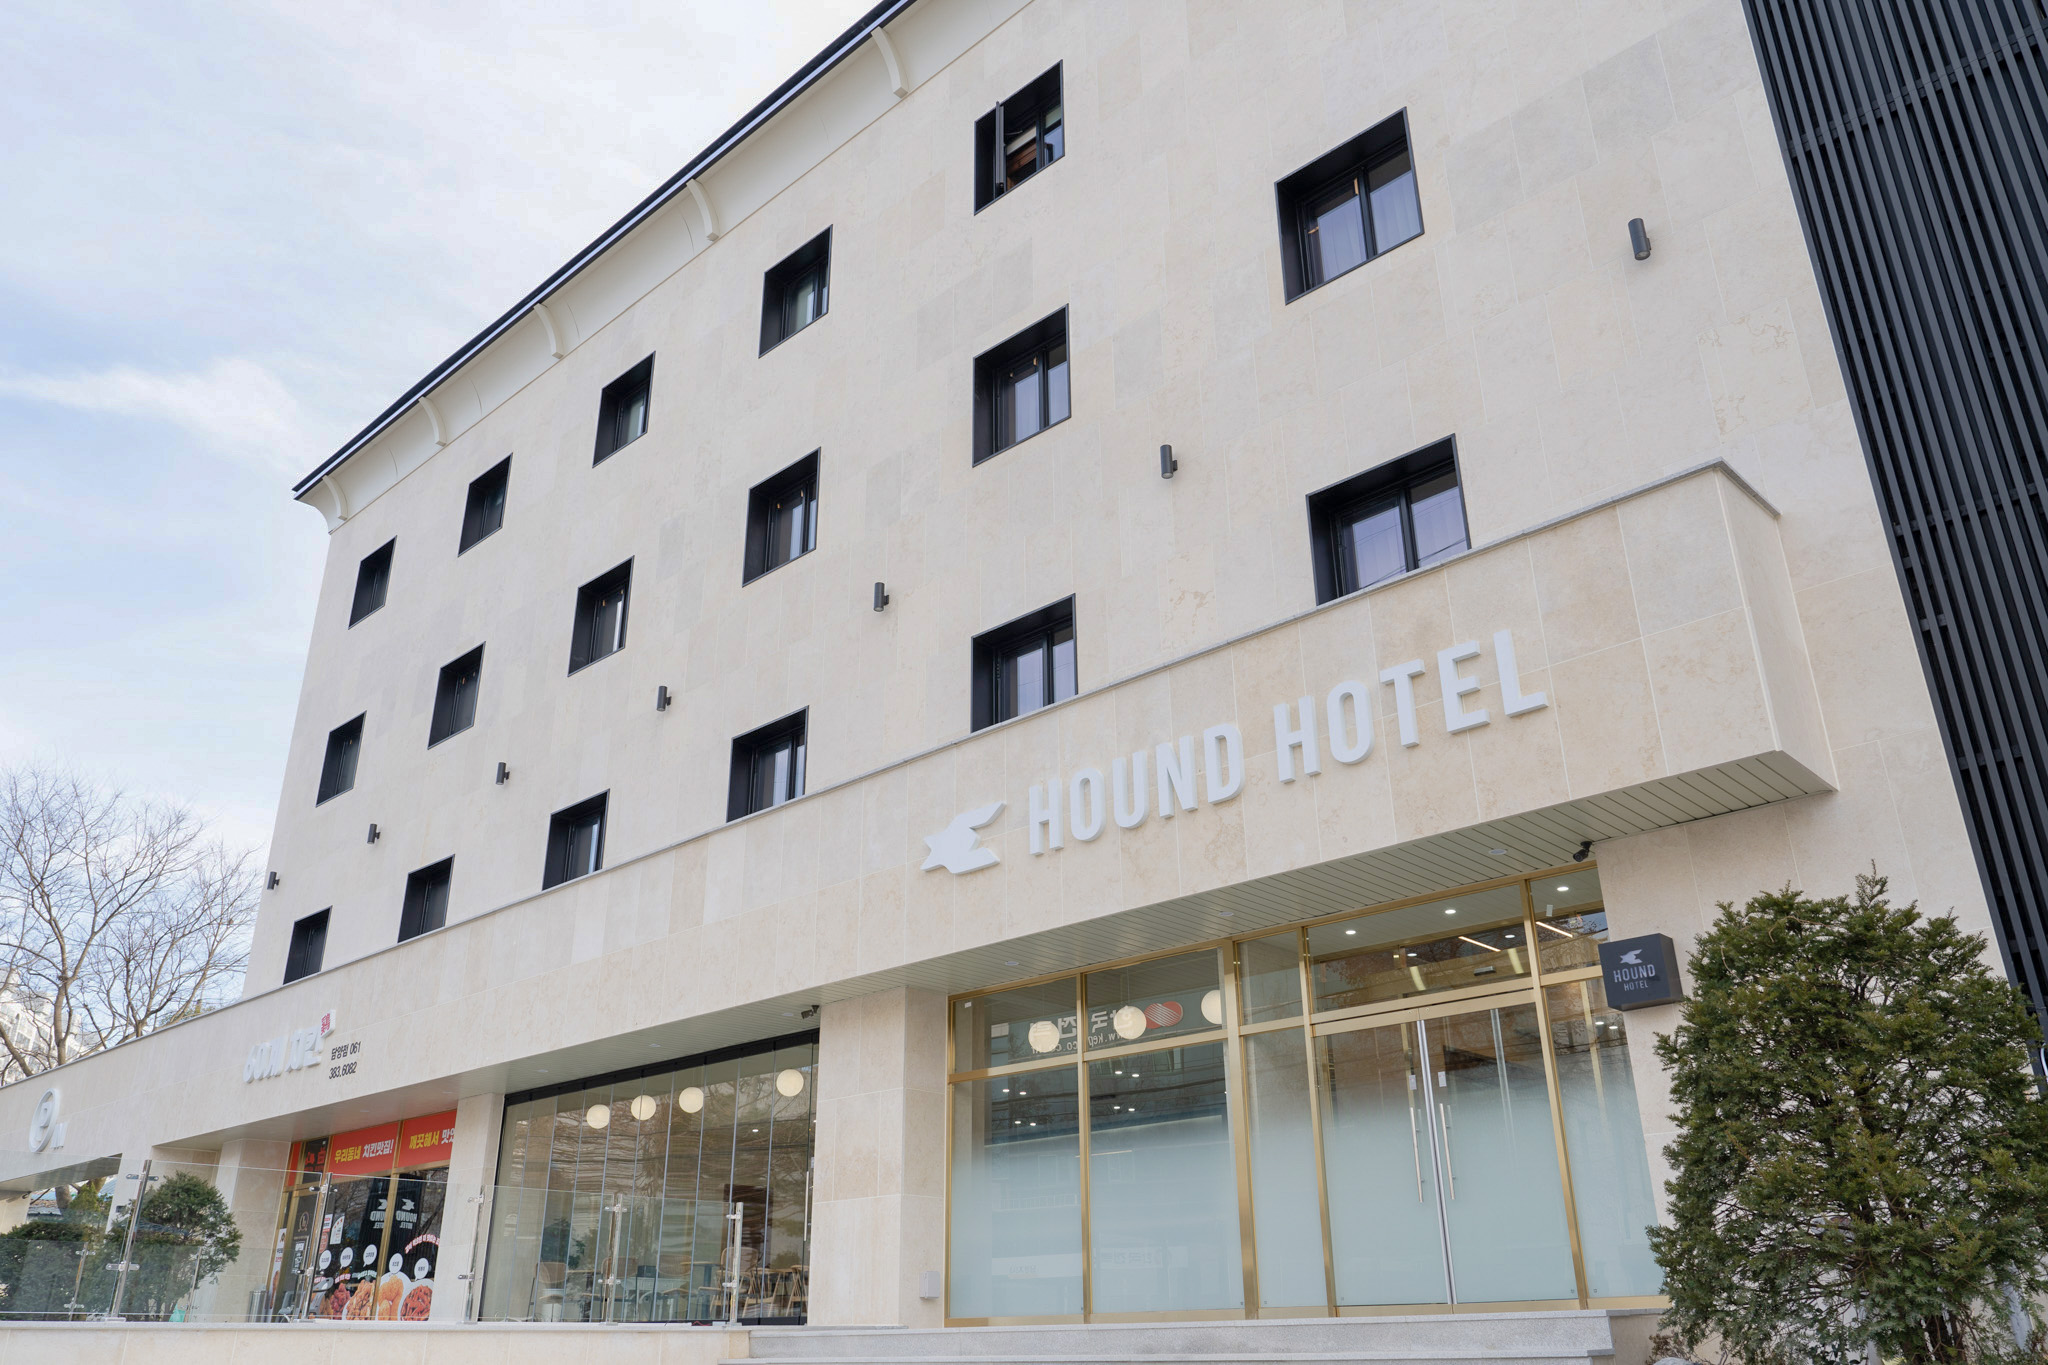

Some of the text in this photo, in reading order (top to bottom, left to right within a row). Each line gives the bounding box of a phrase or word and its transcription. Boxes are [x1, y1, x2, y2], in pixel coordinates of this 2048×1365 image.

[1028, 629, 1548, 856] HOUND HOTEL
[1613, 964, 1656, 983] HOUND
[1623, 980, 1649, 992] HOTEL
[331, 1041, 361, 1061] 담양점 061
[409, 1130, 440, 1150] 깨끗해서
[334, 1145, 362, 1163] 우리동네
[362, 1139, 394, 1159] 치킨맛집!
